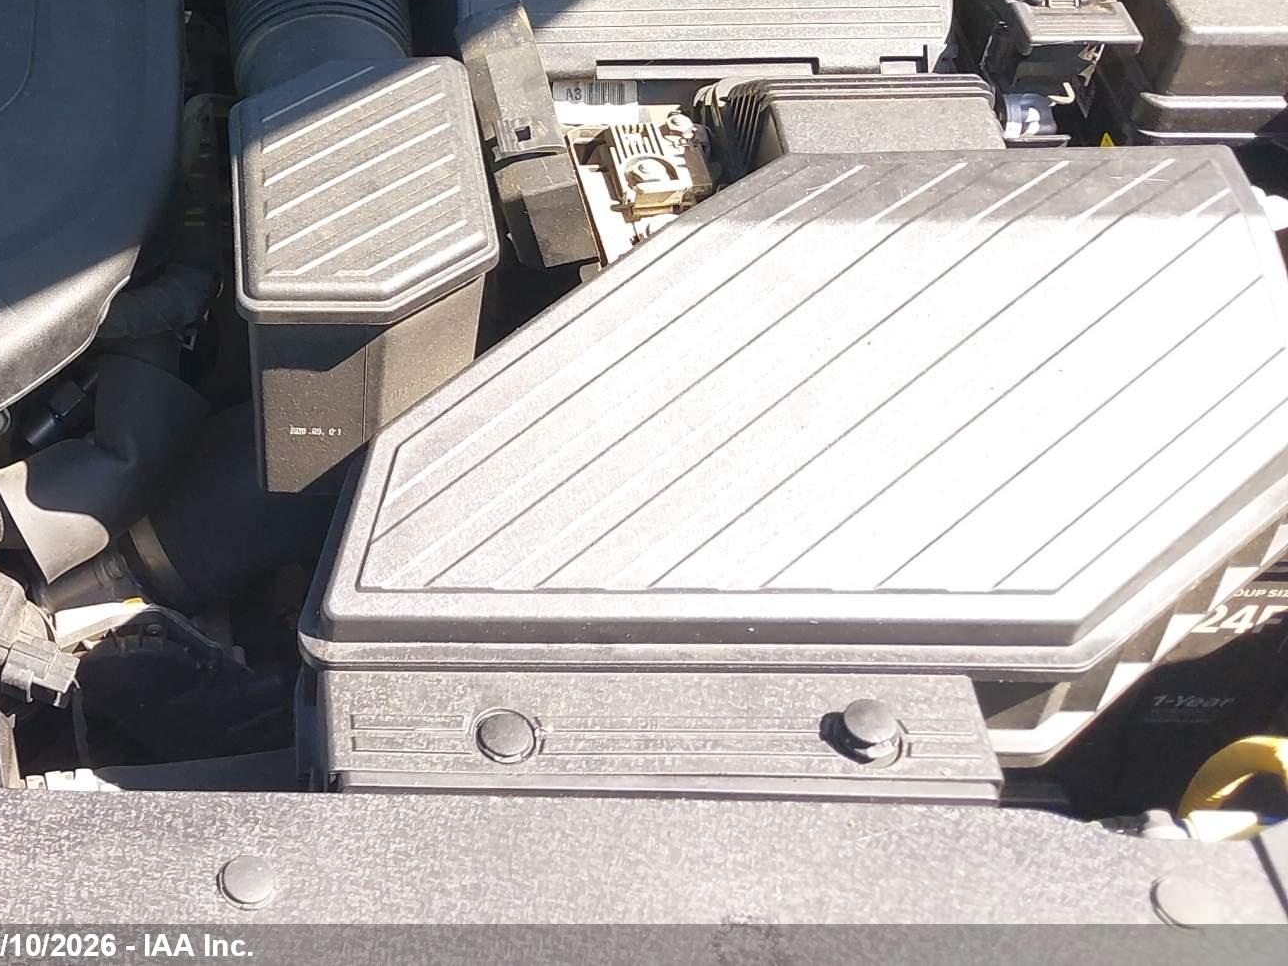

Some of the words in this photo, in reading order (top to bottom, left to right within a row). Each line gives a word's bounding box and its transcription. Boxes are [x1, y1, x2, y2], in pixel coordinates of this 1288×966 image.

[566, 87, 582, 101] A3
[1190, 604, 1288, 634] 24F
[1152, 694, 1236, 708] 1-Year
